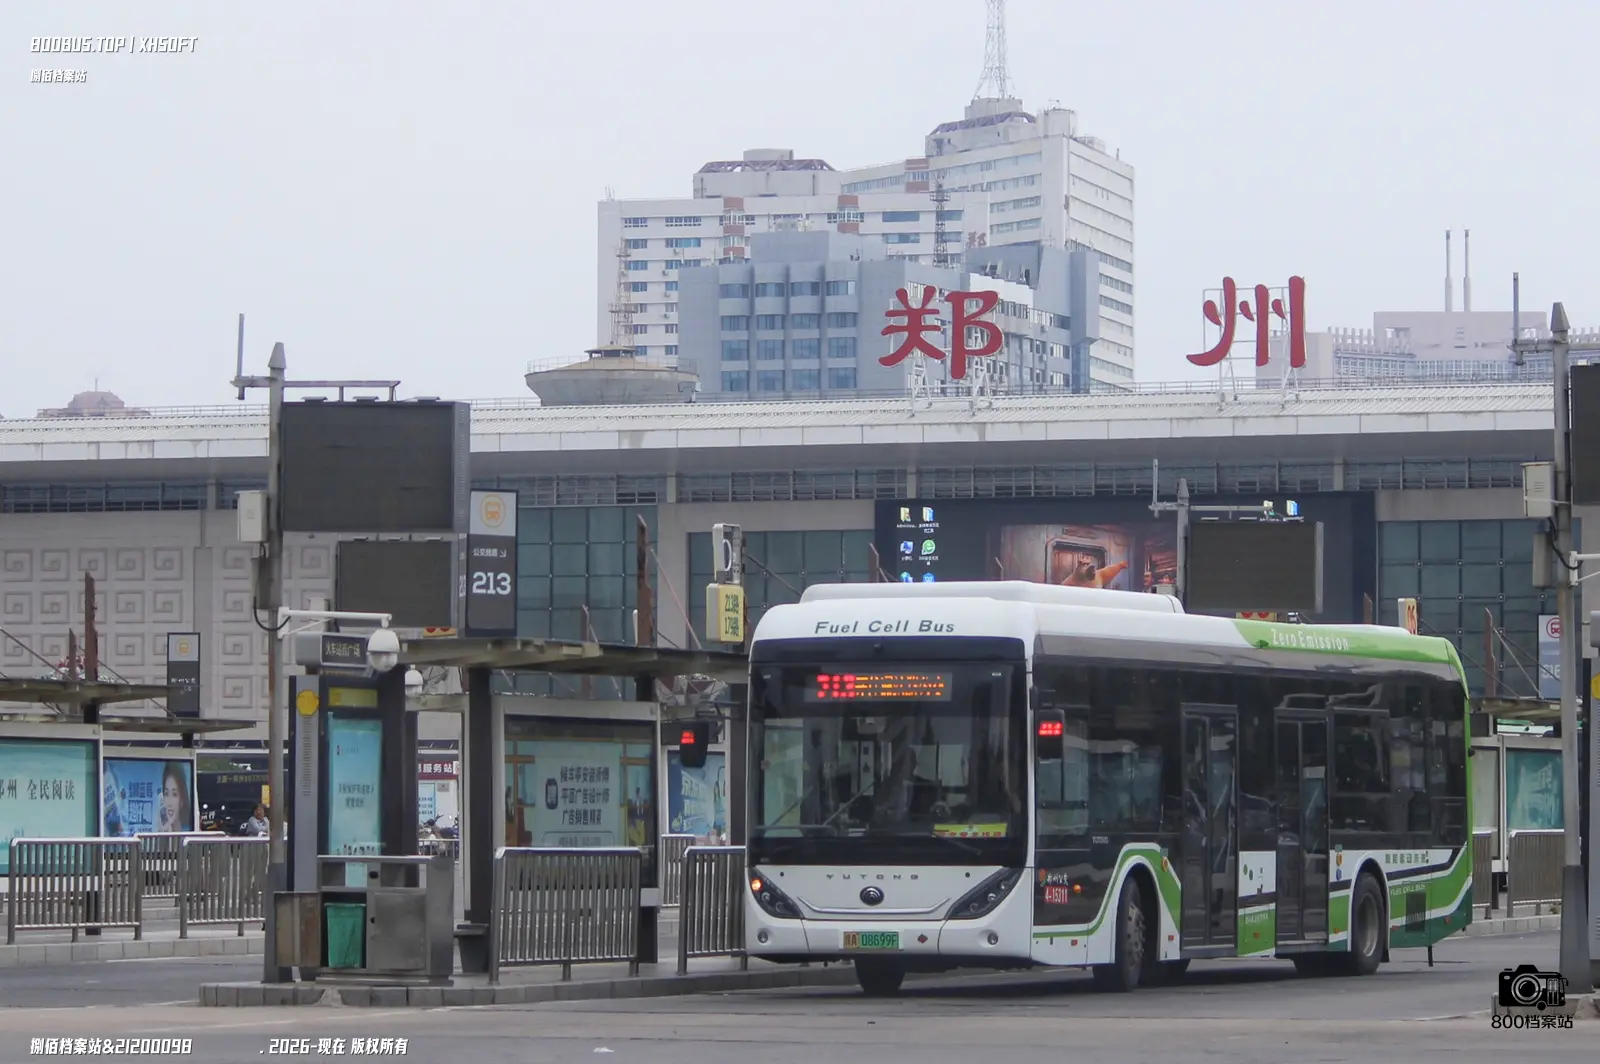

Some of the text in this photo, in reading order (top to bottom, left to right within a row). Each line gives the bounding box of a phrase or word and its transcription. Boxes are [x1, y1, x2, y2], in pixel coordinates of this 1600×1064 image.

[472, 571, 511, 595] 213
[814, 619, 955, 635] Fuel Cell Bus
[1271, 628, 1350, 650] Zero Emission
[27, 779, 75, 800] 全民阅读
[561, 788, 610, 805] 平面广告设计师
